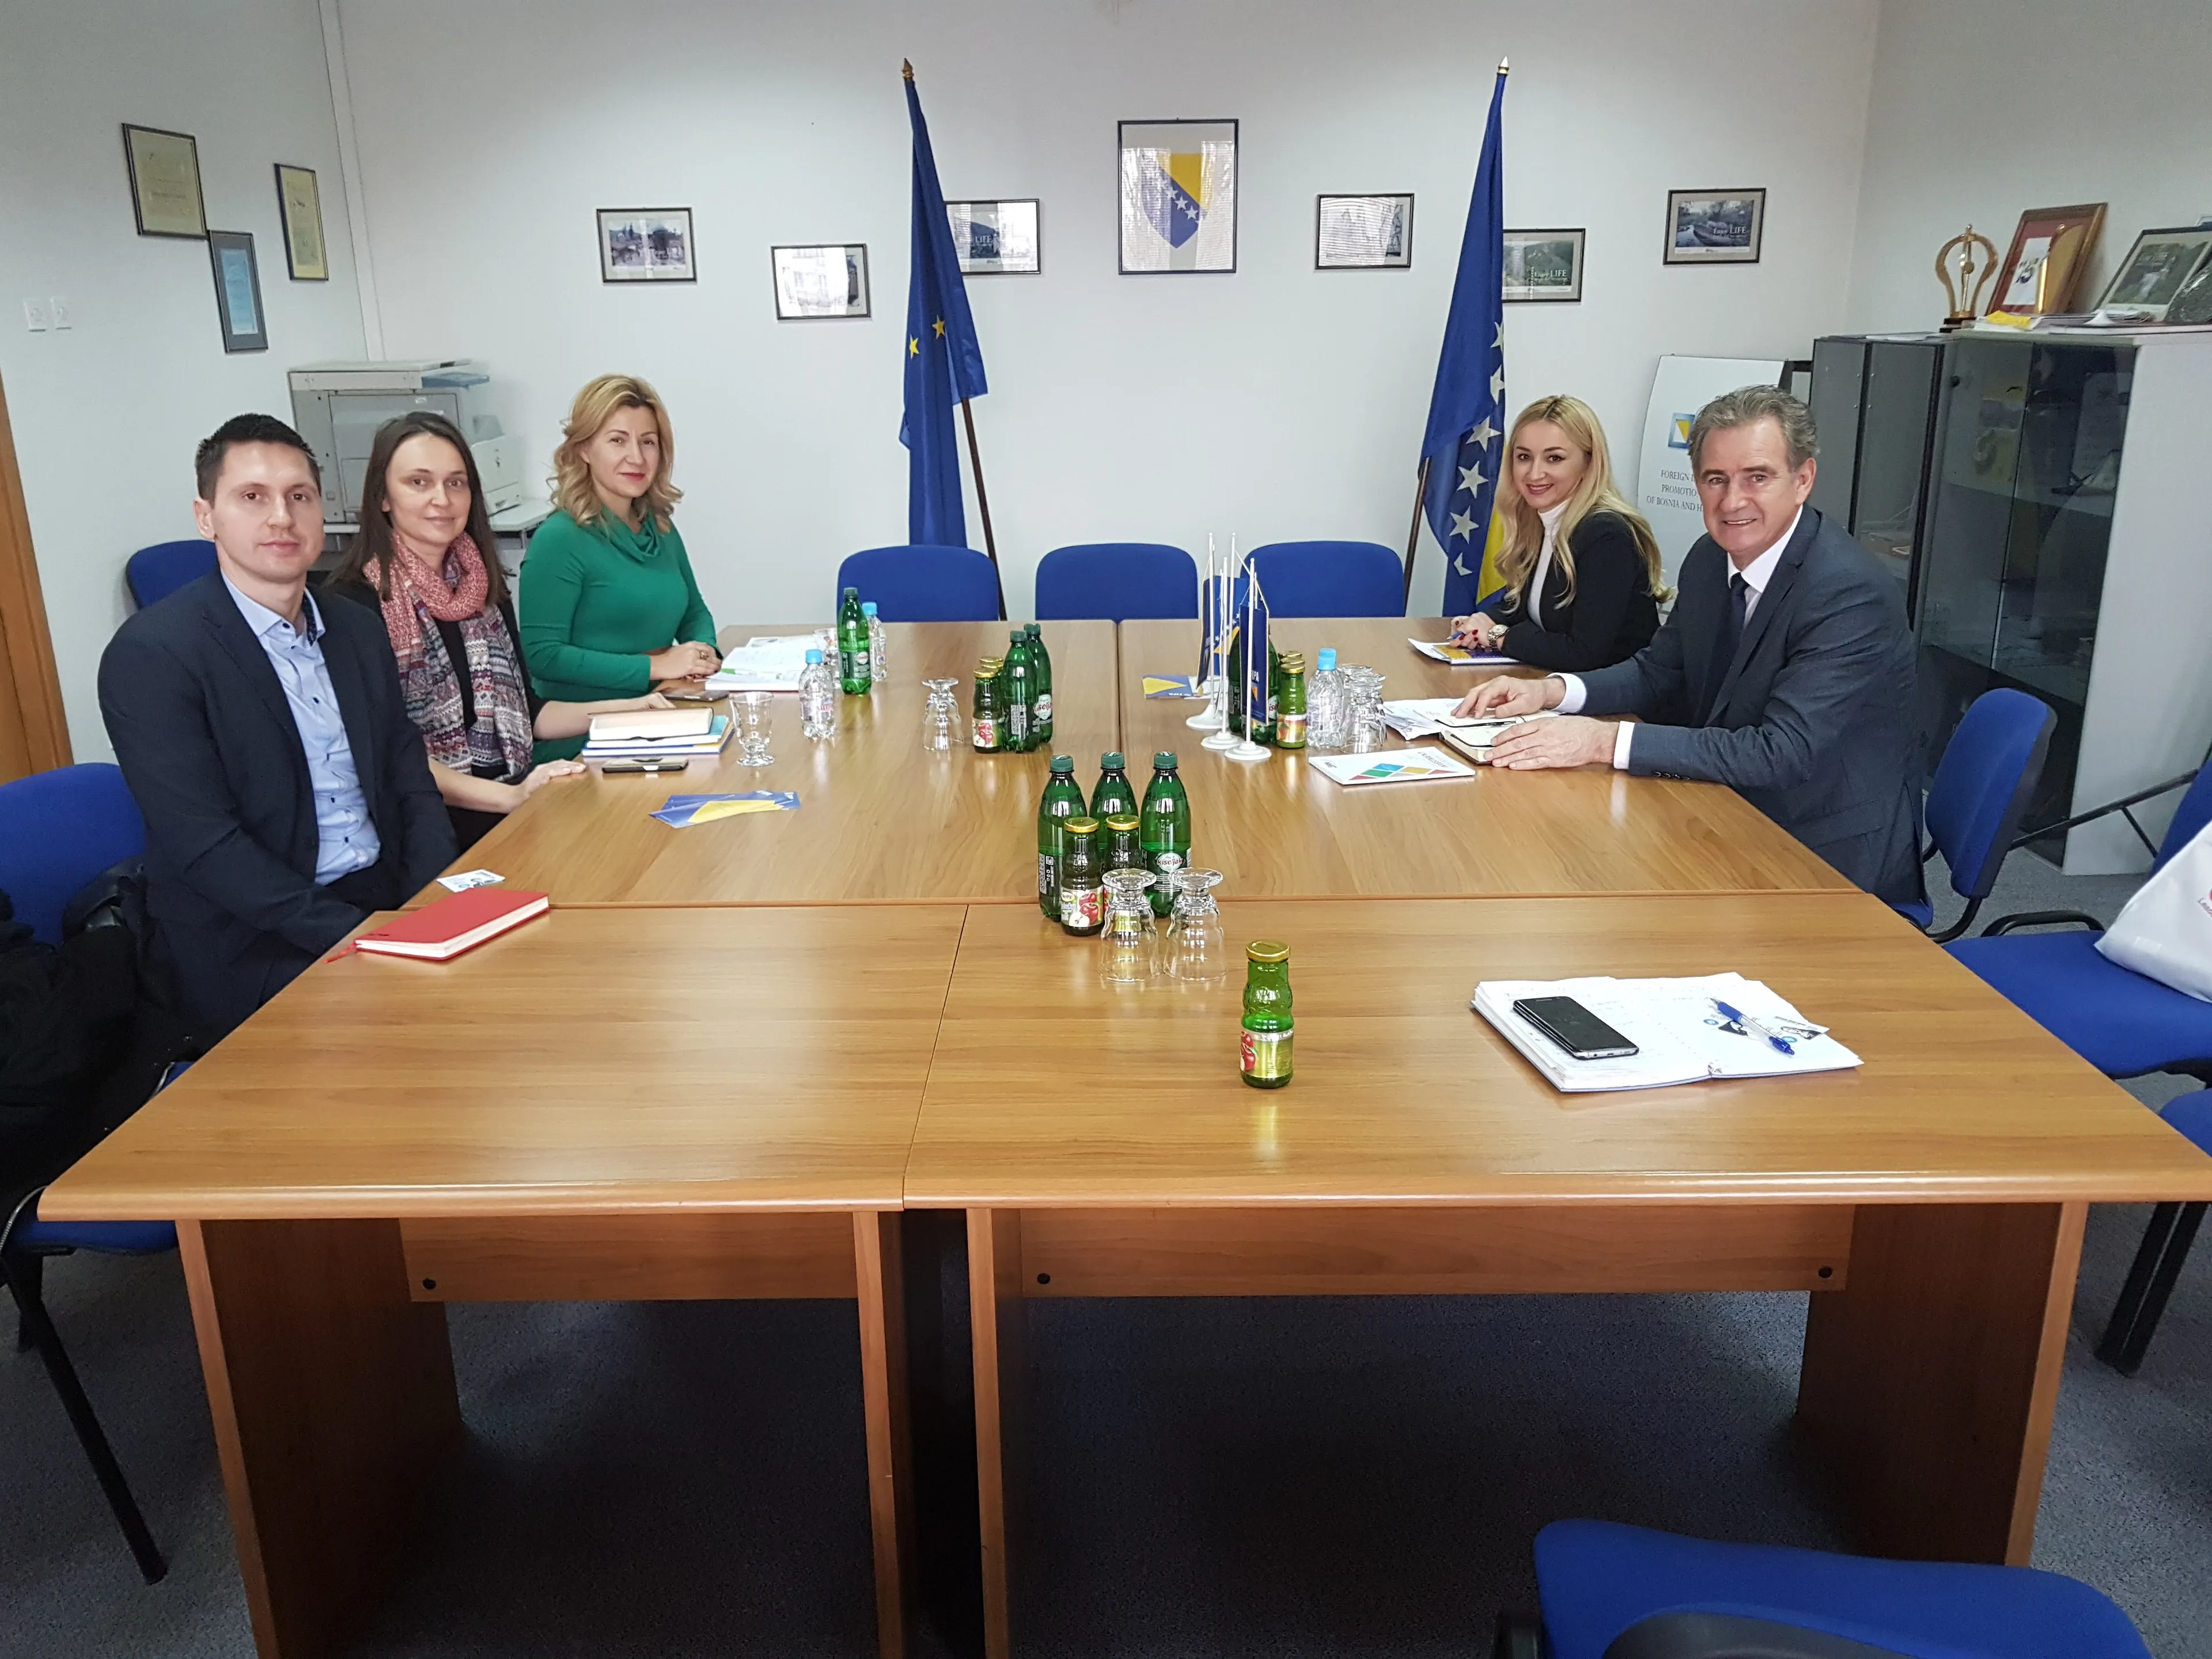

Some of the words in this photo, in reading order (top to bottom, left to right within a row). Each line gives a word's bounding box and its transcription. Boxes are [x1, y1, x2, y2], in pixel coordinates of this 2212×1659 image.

[1729, 224, 1747, 234] LIFE
[975, 235, 992, 243] LIFE
[1550, 269, 1567, 277] LIFE
[1661, 469, 1690, 481] FOREIGN
[1661, 484, 1698, 498] PROMOTIO
[1646, 495, 1655, 504] OF
[1656, 497, 1680, 508] BOSNIA
[1681, 501, 1696, 511] AND
[1696, 503, 1703, 512] H
[1251, 670, 1259, 683] IPA
